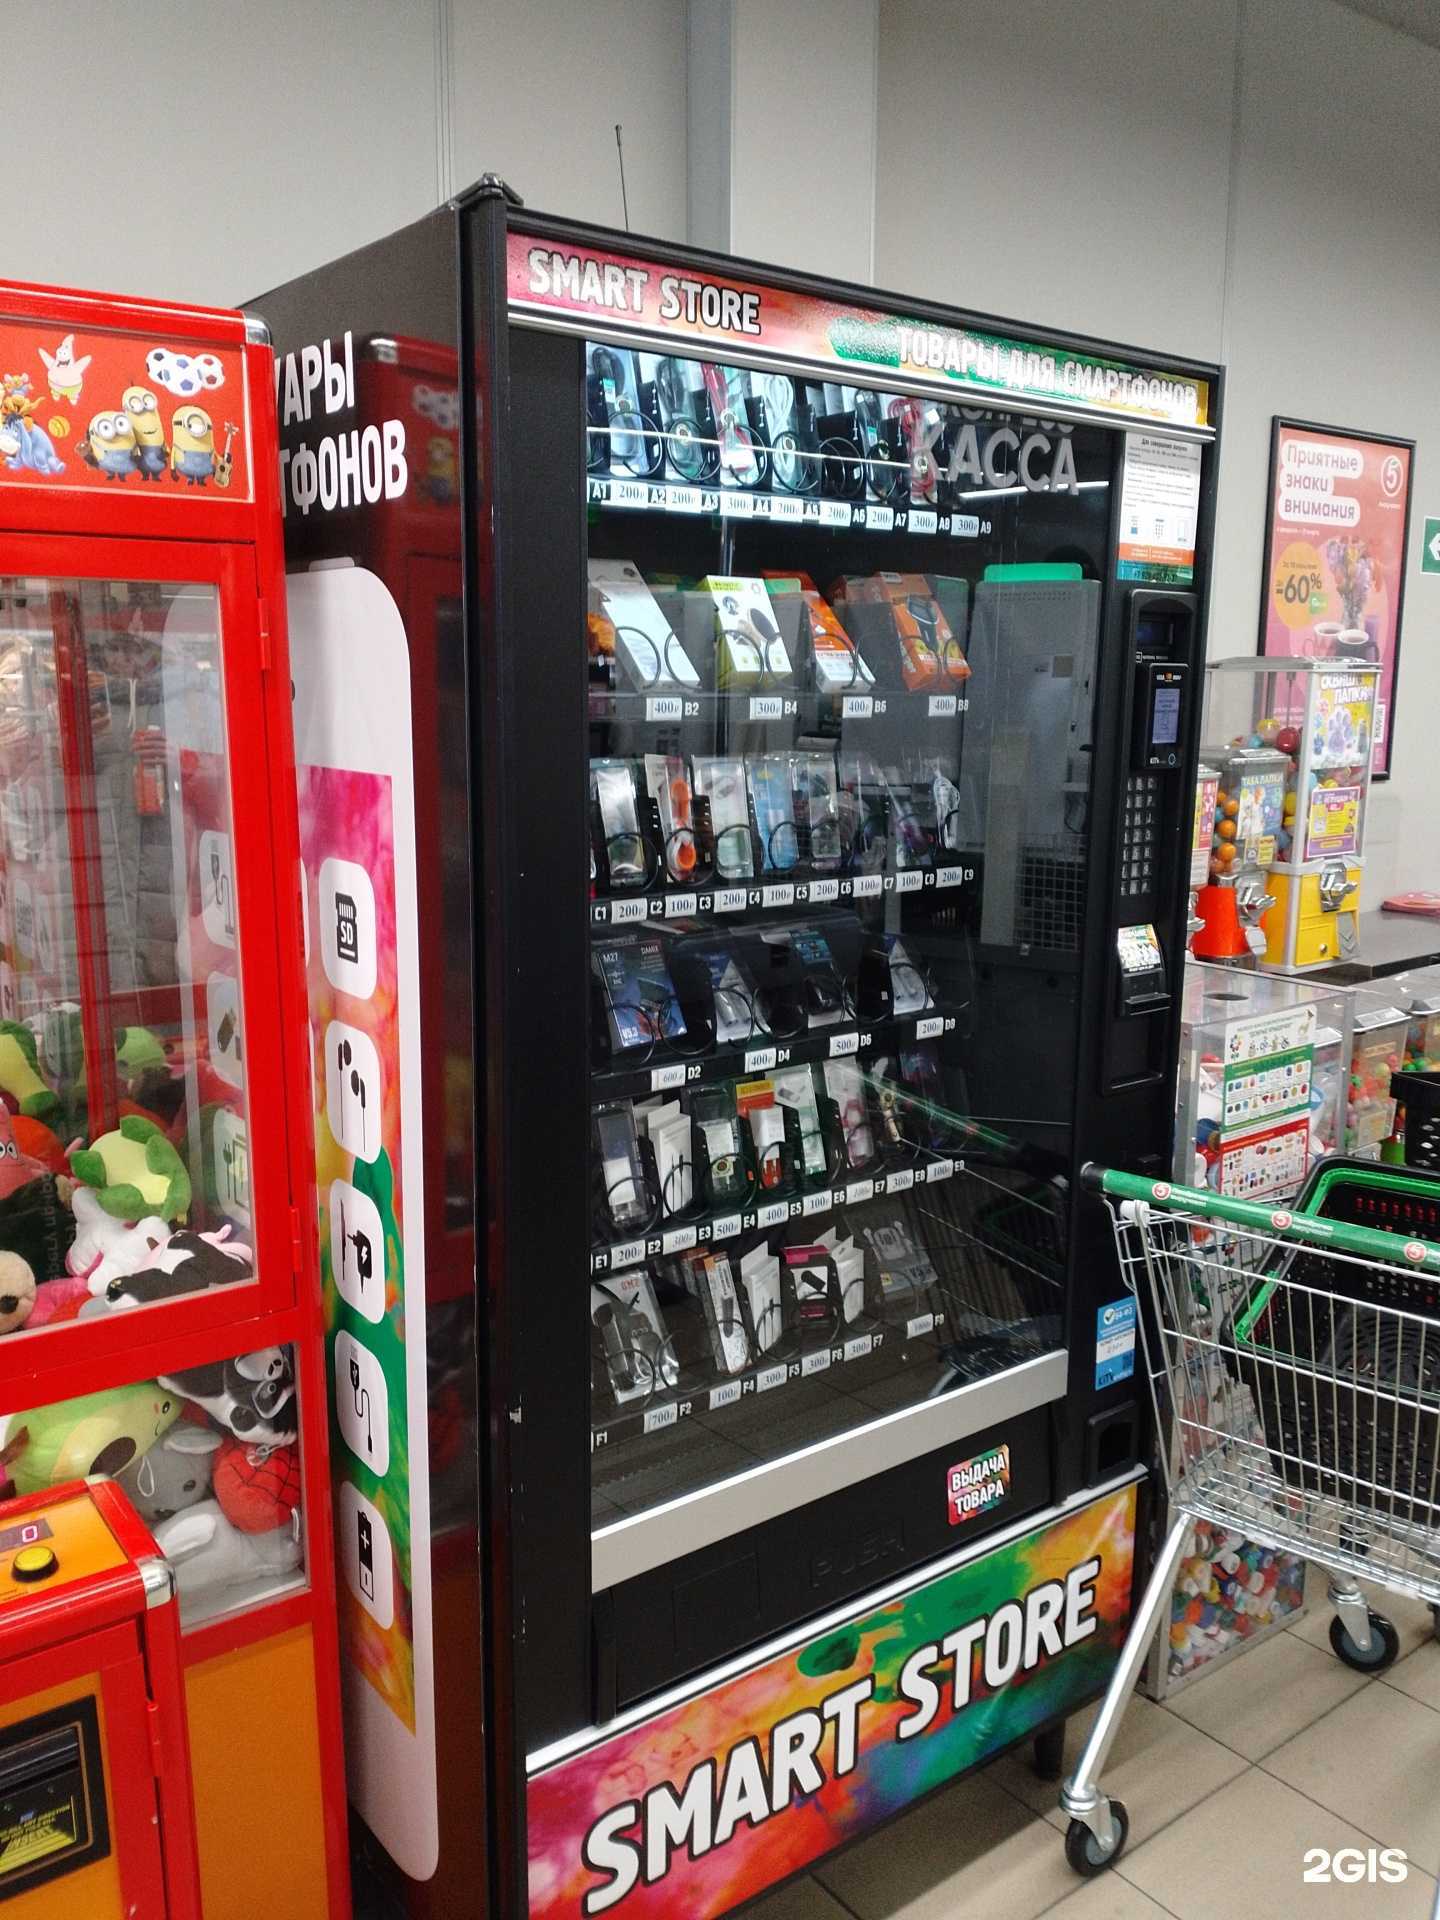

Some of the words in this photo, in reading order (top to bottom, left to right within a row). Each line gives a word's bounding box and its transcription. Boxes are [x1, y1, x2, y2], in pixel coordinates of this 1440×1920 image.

[527, 248, 648, 313] SMART
[659, 275, 761, 336] STORE
[899, 327, 1000, 381] ТОВАРЫ
[1007, 349, 1057, 391] ДЛЯ
[1063, 361, 1197, 413] СМАРТФОНОВ
[1287, 444, 1358, 471] Приятные
[1286, 473, 1329, 492] знаки
[593, 484, 608, 499] A1
[650, 488, 667, 504] A2
[853, 508, 865, 523] A6
[1284, 498, 1355, 520] внимания
[895, 513, 907, 527] A7
[938, 516, 950, 531] A8
[980, 521, 992, 534] A9
[685, 702, 700, 716] B2
[784, 702, 798, 715] B4
[924, 872, 935, 886] C8
[964, 868, 974, 880] C9
[840, 881, 852, 895] C6
[884, 876, 894, 890] C7
[749, 890, 760, 904] C4
[796, 886, 808, 900] C5
[650, 901, 663, 915] C2
[699, 896, 711, 910] C3
[594, 907, 607, 921] C1
[340, 920, 354, 945] SD
[778, 1049, 790, 1063] D4
[688, 1066, 701, 1080] D2
[915, 1169, 926, 1182] E8
[875, 1180, 886, 1194] E7
[834, 1190, 845, 1203] E6
[790, 1202, 801, 1216] E5
[743, 1215, 755, 1228] E4
[699, 1226, 711, 1240] E3
[648, 1240, 661, 1254] E2
[595, 1254, 608, 1269] E1
[873, 1334, 884, 1347] F7
[832, 1349, 843, 1361] F6
[789, 1363, 800, 1377] F5
[679, 1402, 692, 1416] F2
[596, 1431, 608, 1447] F1
[951, 1452, 1006, 1492] ВЫДАЧА
[954, 1479, 1005, 1515] ТОВАРА
[581, 1676, 875, 1917] SMART
[897, 1555, 1102, 1740] STORE
